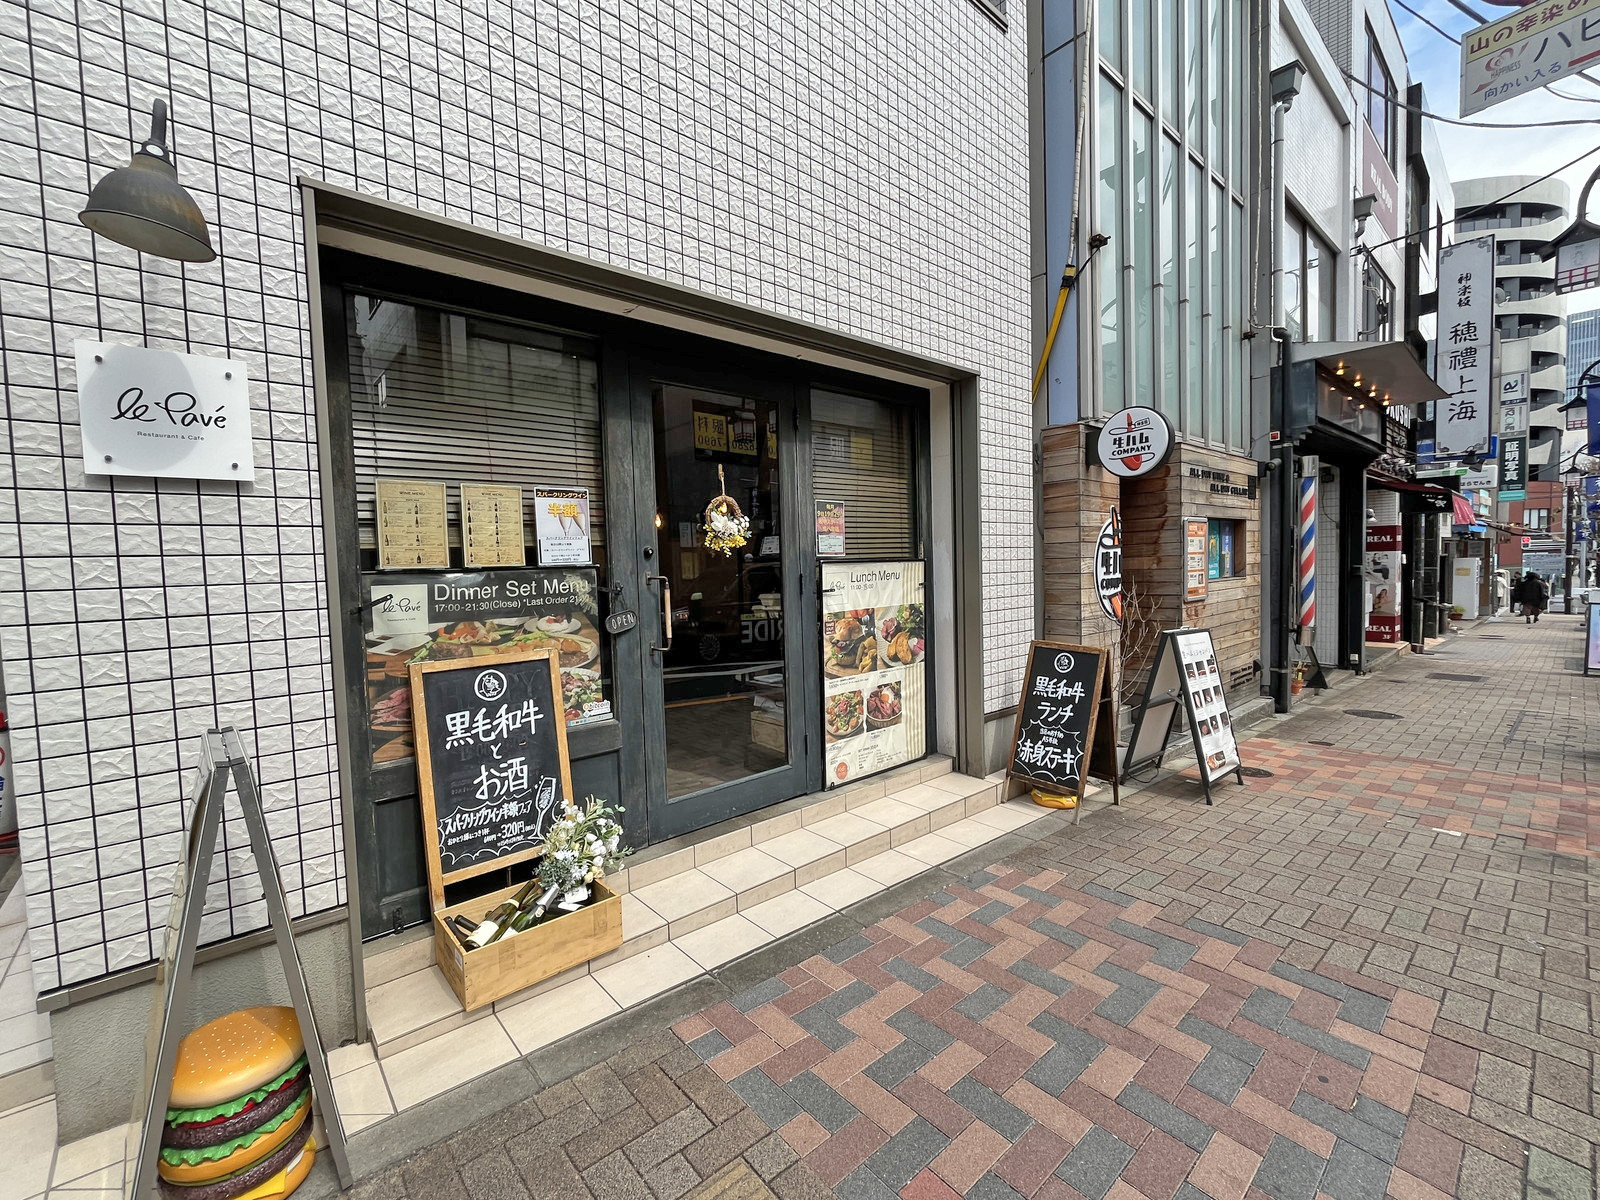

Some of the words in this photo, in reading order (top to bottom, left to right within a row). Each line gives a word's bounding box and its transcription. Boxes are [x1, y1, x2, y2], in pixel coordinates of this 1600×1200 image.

[1490, 60, 1521, 79] HAPPINESS
[1484, 61, 1562, 101] 向かい入る
[1457, 272, 1472, 307] 神楽坂
[1448, 320, 1479, 424] 穂禮上海
[109, 386, 157, 423] le
[153, 391, 227, 429] Pavé
[136, 431, 179, 440] Restaurant
[1112, 432, 1150, 449] 生ハム
[1111, 444, 1153, 457] COMPANY
[1504, 440, 1519, 482] 証明写真
[547, 502, 579, 518] 半額
[1366, 535, 1393, 543] REAL
[850, 571, 878, 583] Lunch
[878, 569, 901, 581] Menu
[434, 583, 499, 601] Dinner
[505, 579, 538, 598] Set
[543, 577, 589, 595] Menu
[434, 599, 522, 613] 17:00-21:30(Close)
[544, 595, 568, 606] Order
[611, 612, 636, 630] OPEN
[1366, 624, 1392, 633] REAL
[1032, 675, 1086, 704] 黒毛和牛
[1037, 701, 1074, 724] ランチ
[445, 699, 545, 750] 黒毛和牛
[489, 742, 502, 760] と
[1019, 738, 1076, 775] 赤身ステーキ
[472, 756, 528, 800] お酒
